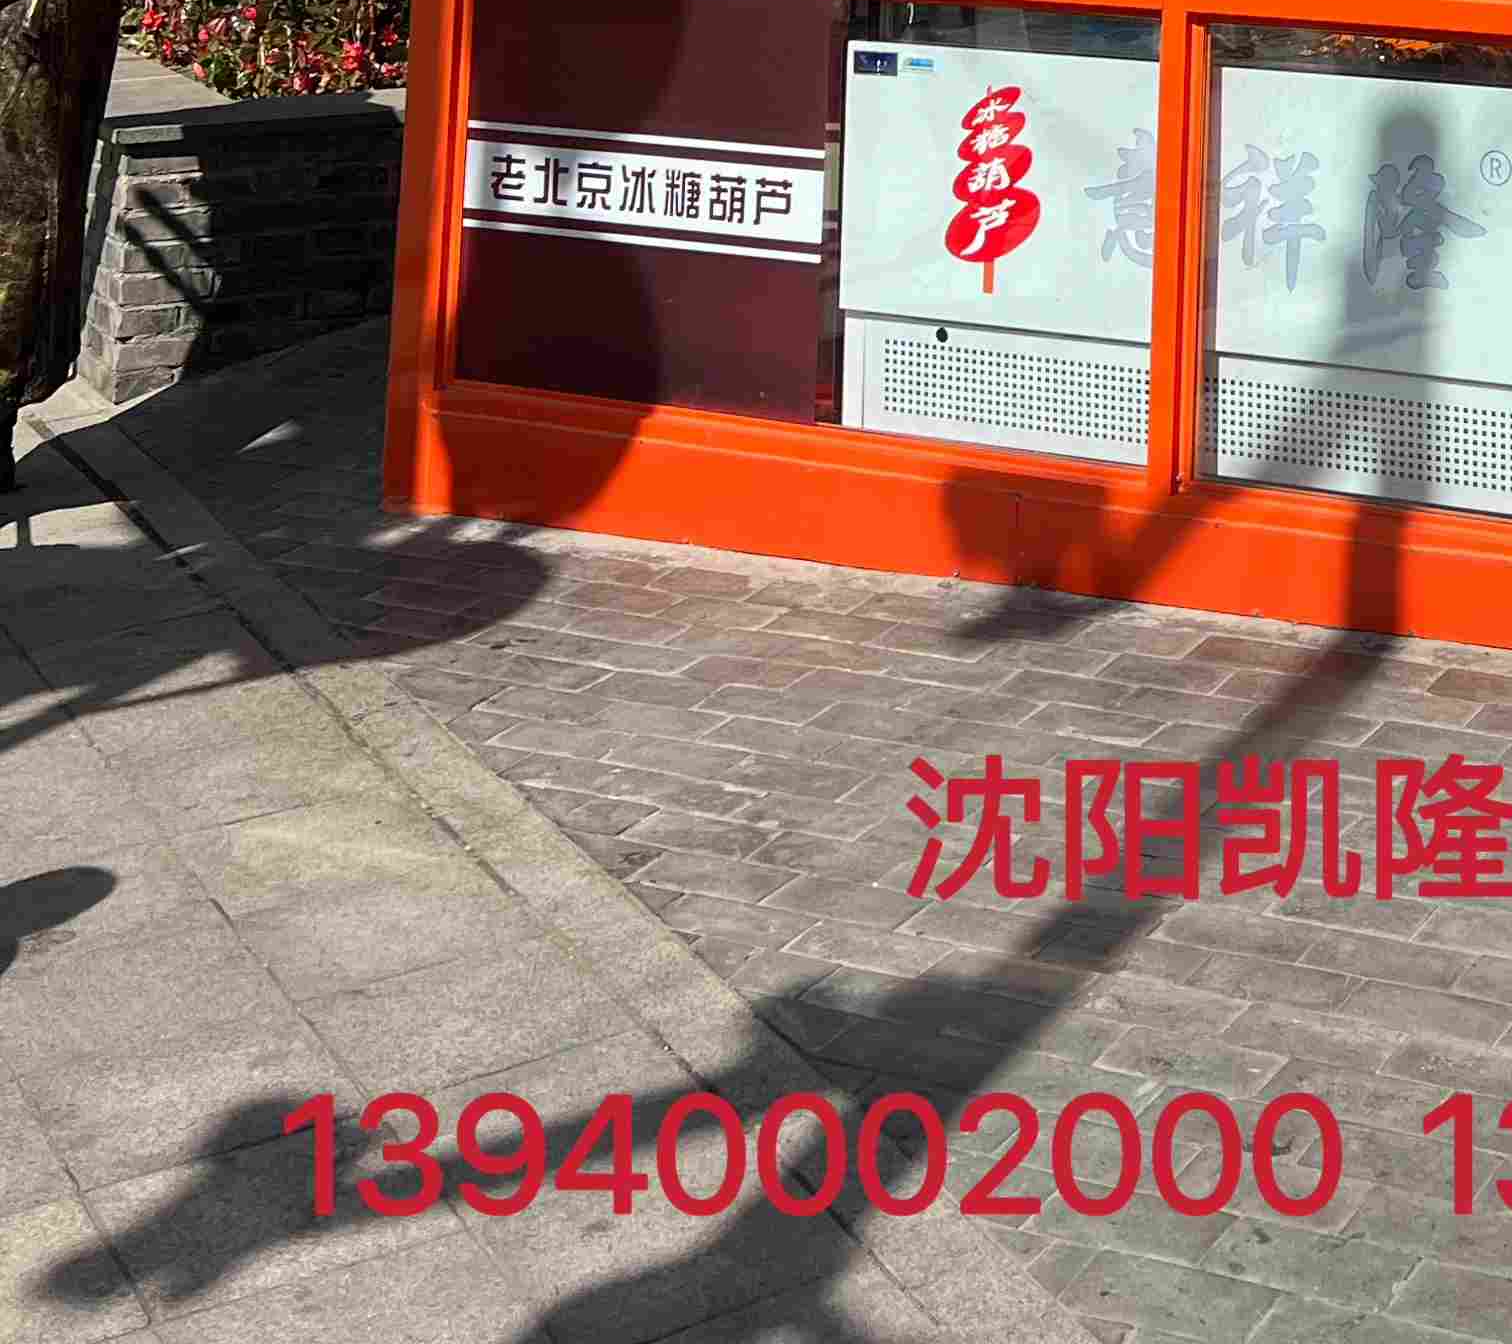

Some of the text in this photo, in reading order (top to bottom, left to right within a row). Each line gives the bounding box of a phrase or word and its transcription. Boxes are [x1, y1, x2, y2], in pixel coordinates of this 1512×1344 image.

[490, 154, 793, 225] 老北京冰糖葫芦
[960, 97, 1017, 256] 冰糖葫芦
